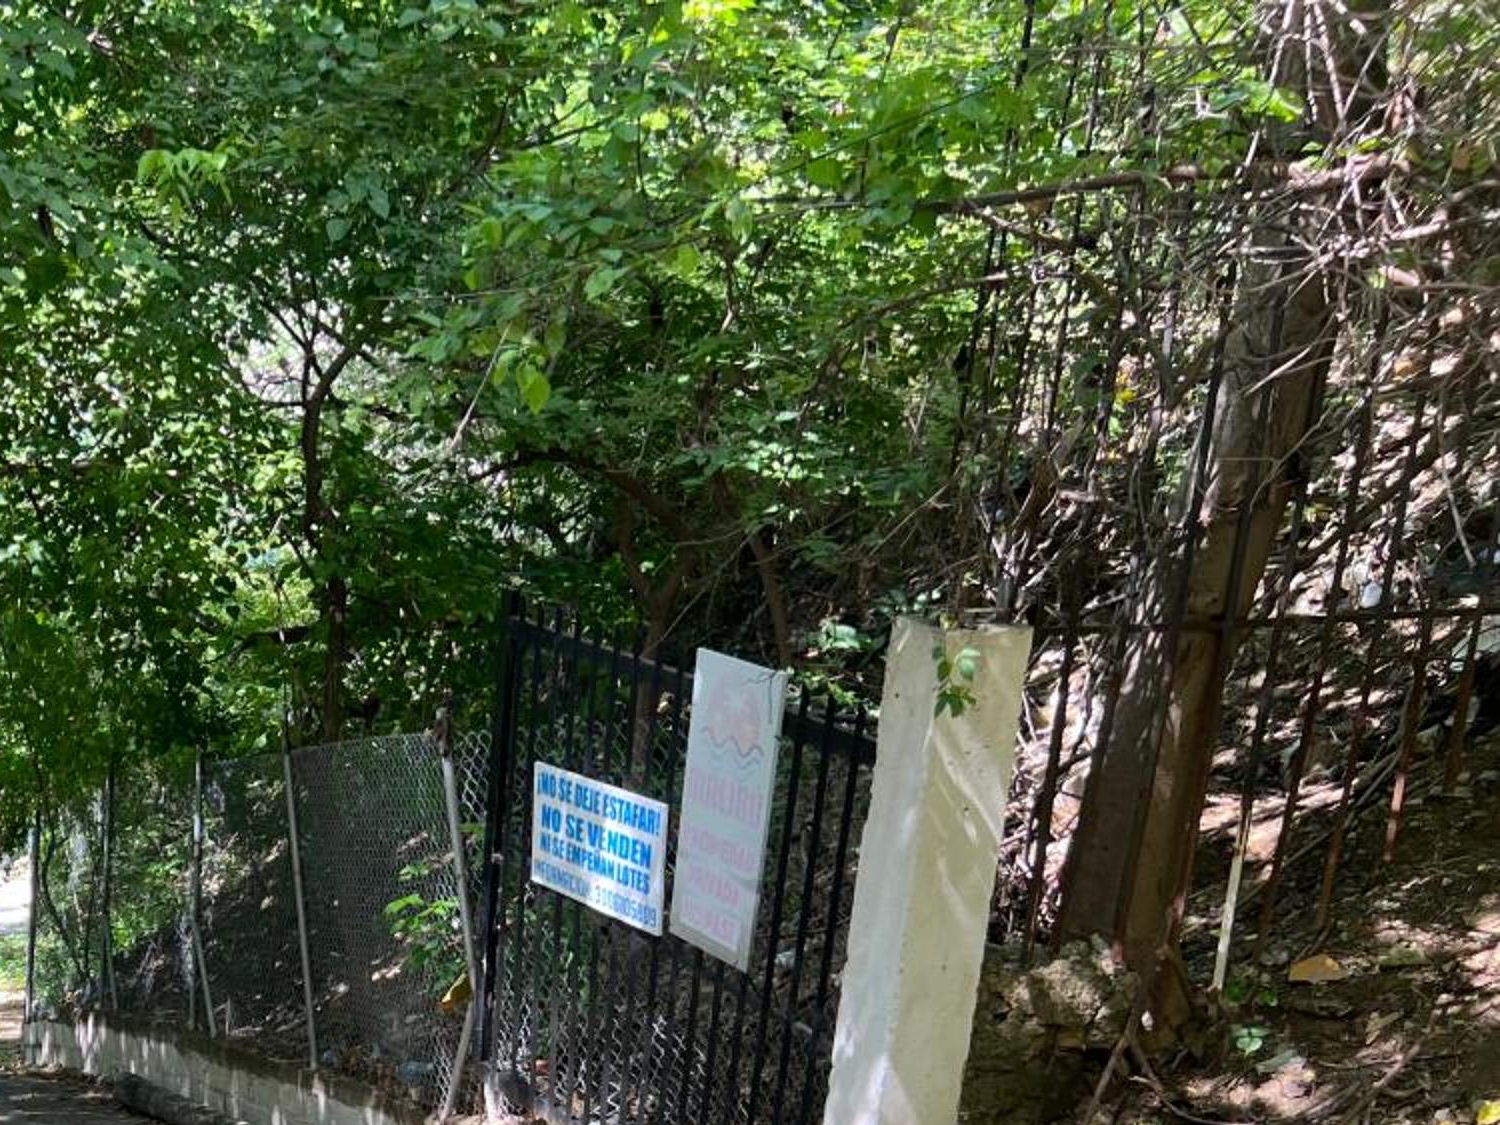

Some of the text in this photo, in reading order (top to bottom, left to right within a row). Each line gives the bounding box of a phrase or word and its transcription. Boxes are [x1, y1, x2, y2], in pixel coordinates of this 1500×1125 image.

[541, 804, 652, 869] NO SE VENDEN
[558, 777, 571, 803] SE
[575, 781, 600, 814] DEJE
[603, 792, 661, 836] ESTAFAR!
[540, 834, 650, 895] NI SE EMPEÑAN LOTES
